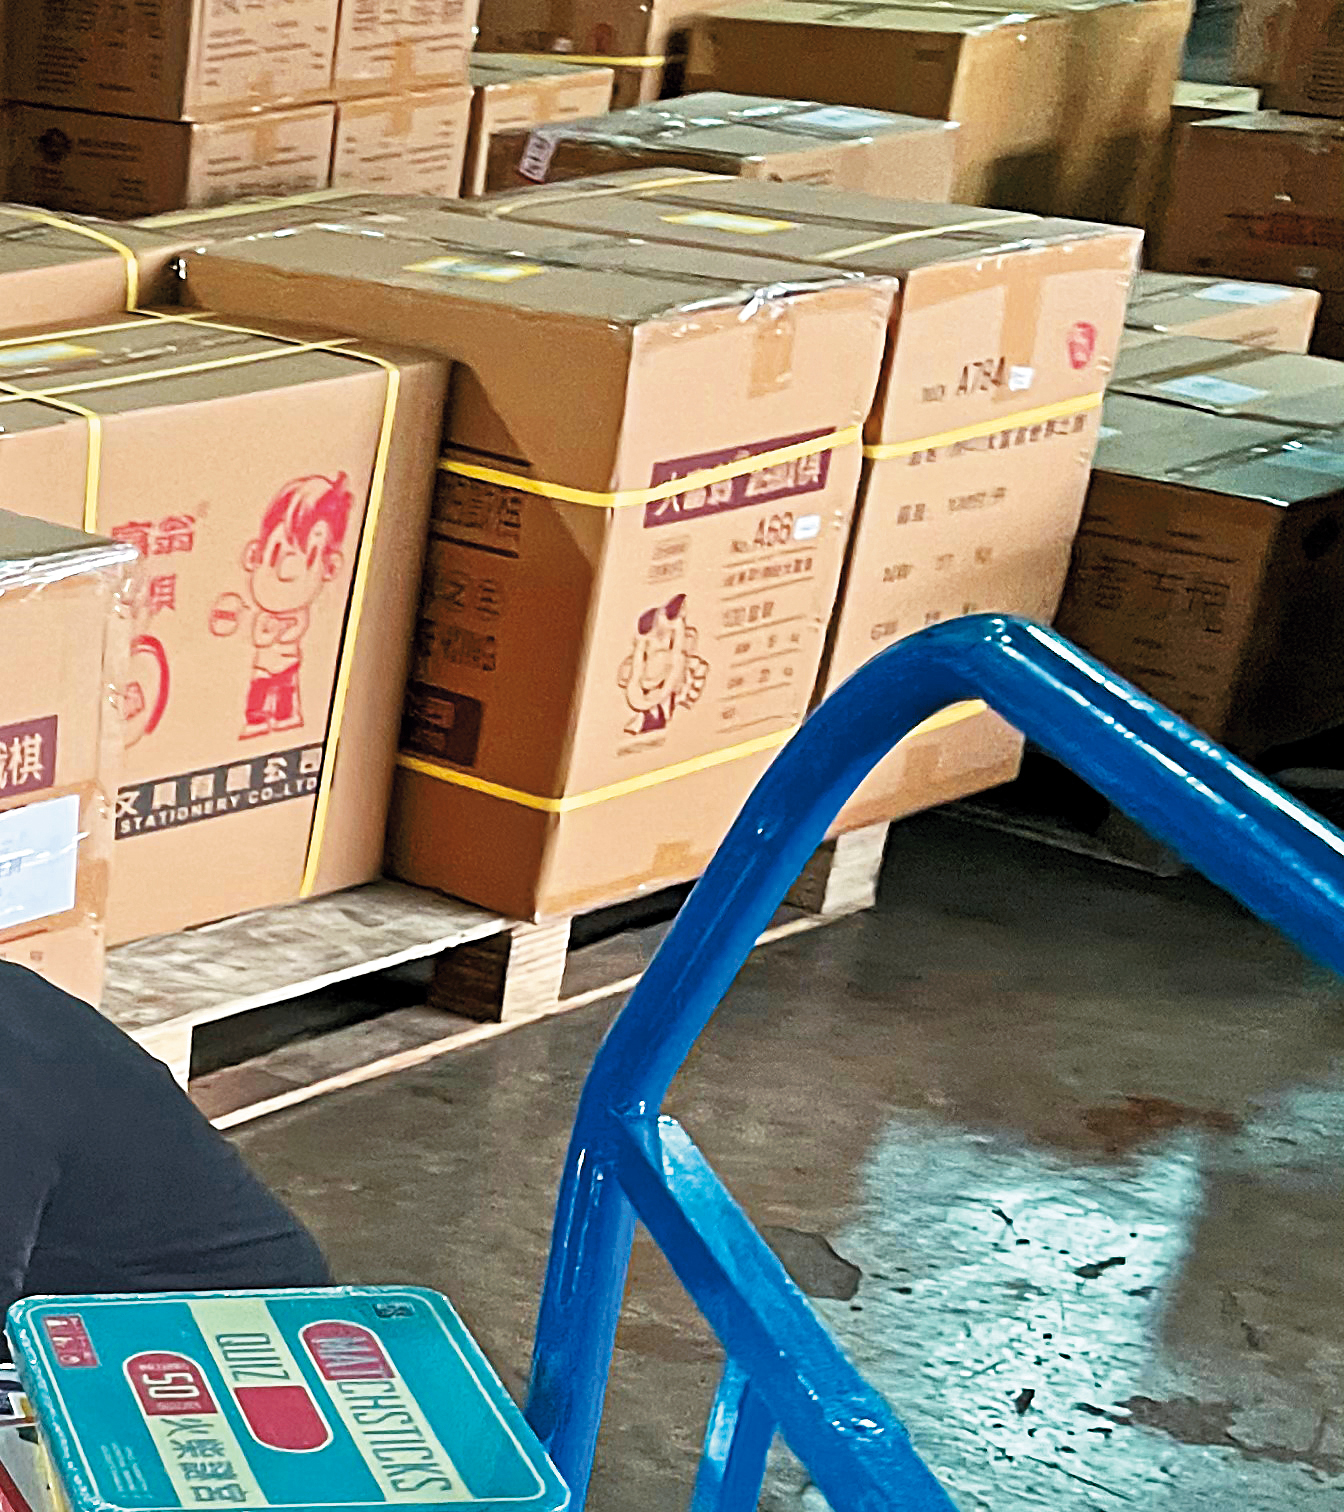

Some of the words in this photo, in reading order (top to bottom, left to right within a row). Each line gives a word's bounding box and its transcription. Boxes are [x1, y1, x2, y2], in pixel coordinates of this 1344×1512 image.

[120, 793, 239, 835] STATIONERY
[215, 1332, 291, 1382] QUIZ
[311, 1337, 453, 1494] MATCHSTICKS
